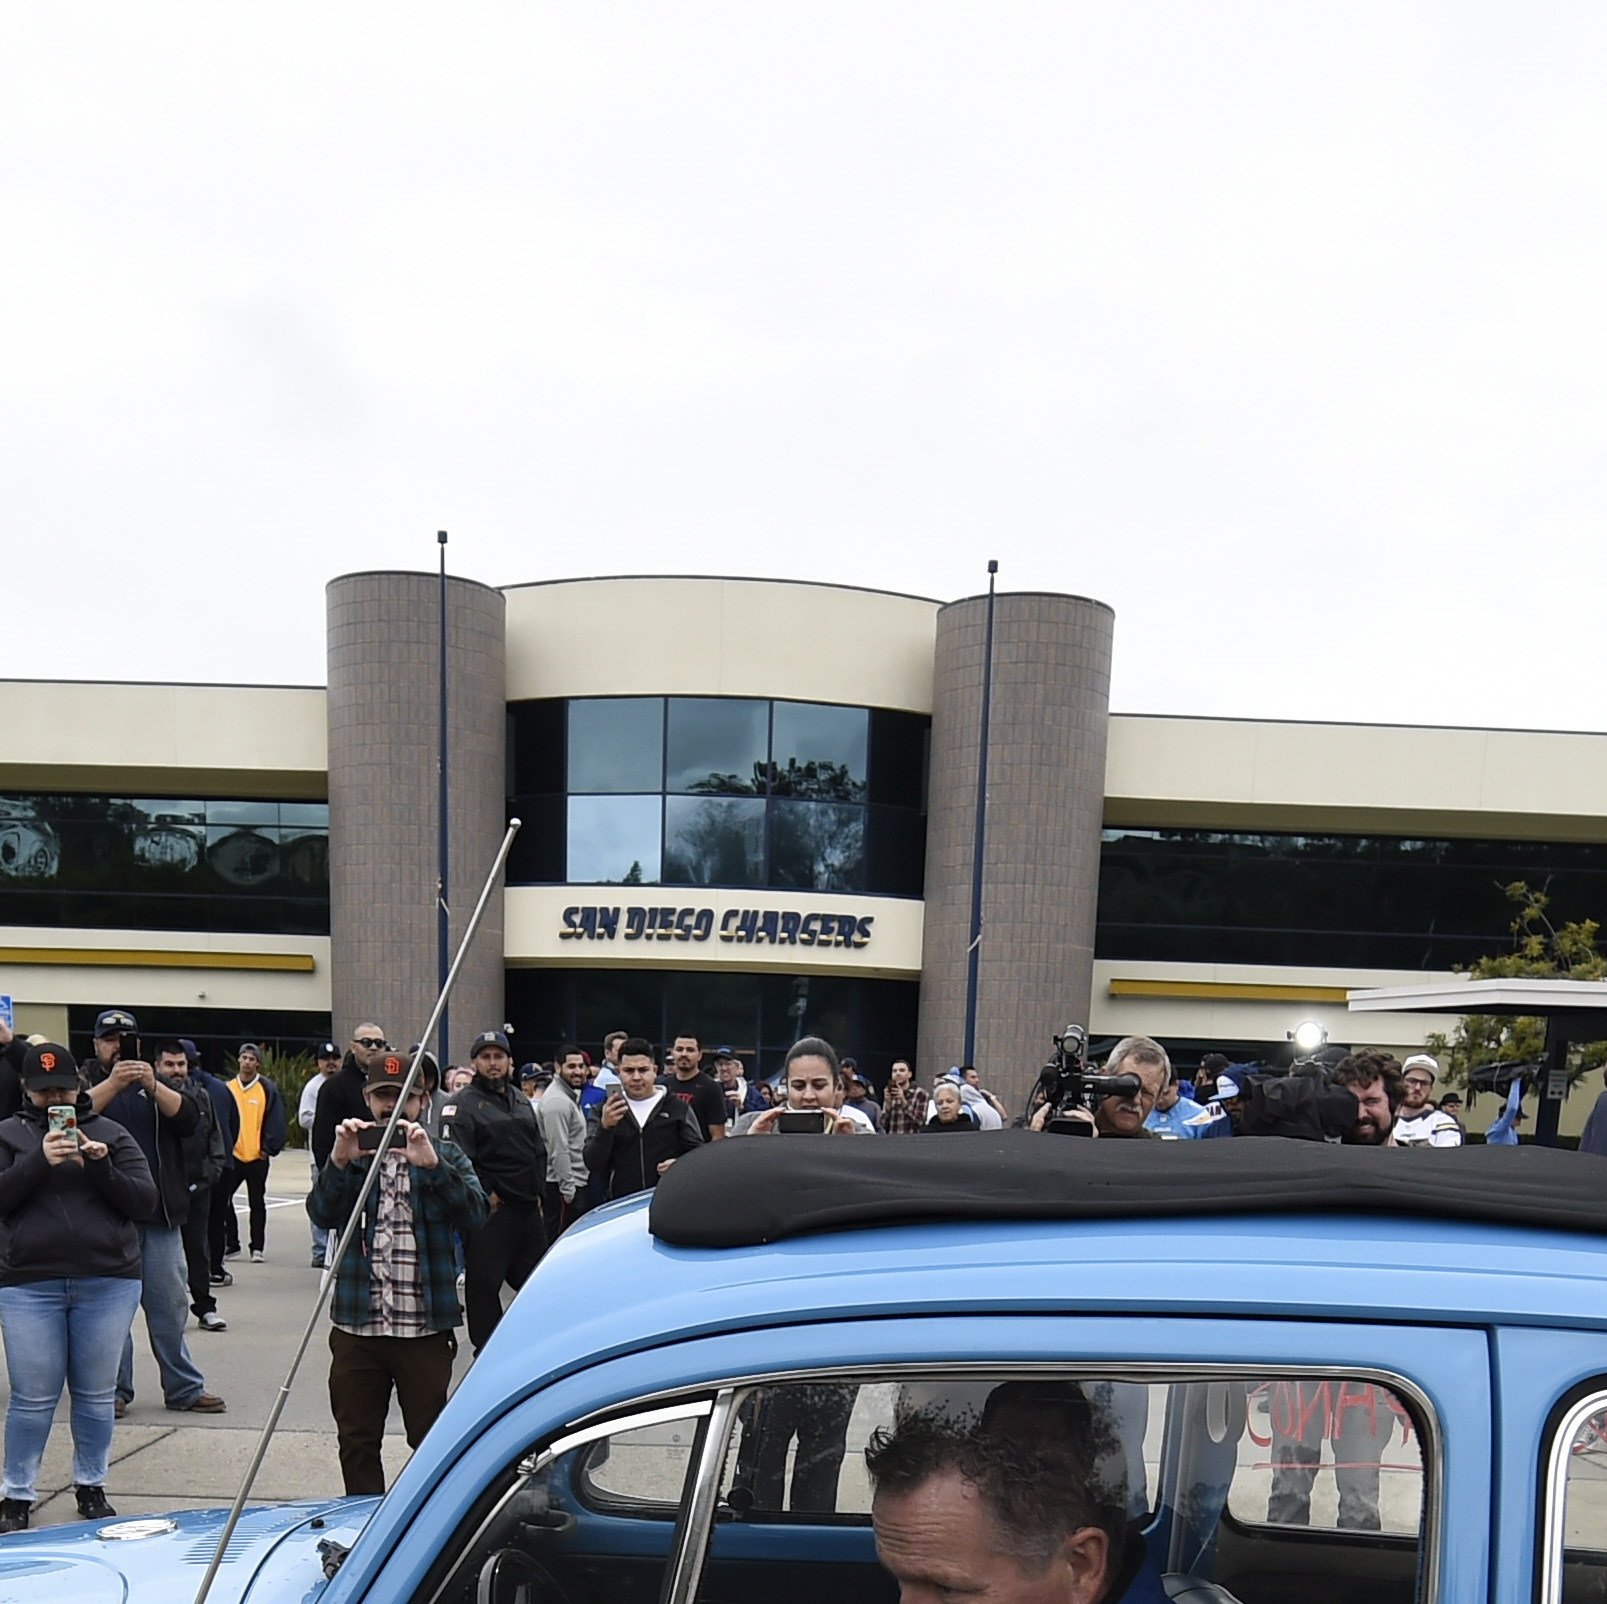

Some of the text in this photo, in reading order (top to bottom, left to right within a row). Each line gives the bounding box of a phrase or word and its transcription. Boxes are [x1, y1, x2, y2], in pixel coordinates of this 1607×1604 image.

[559, 906, 874, 949] SAN DIEGO CHARGERS
